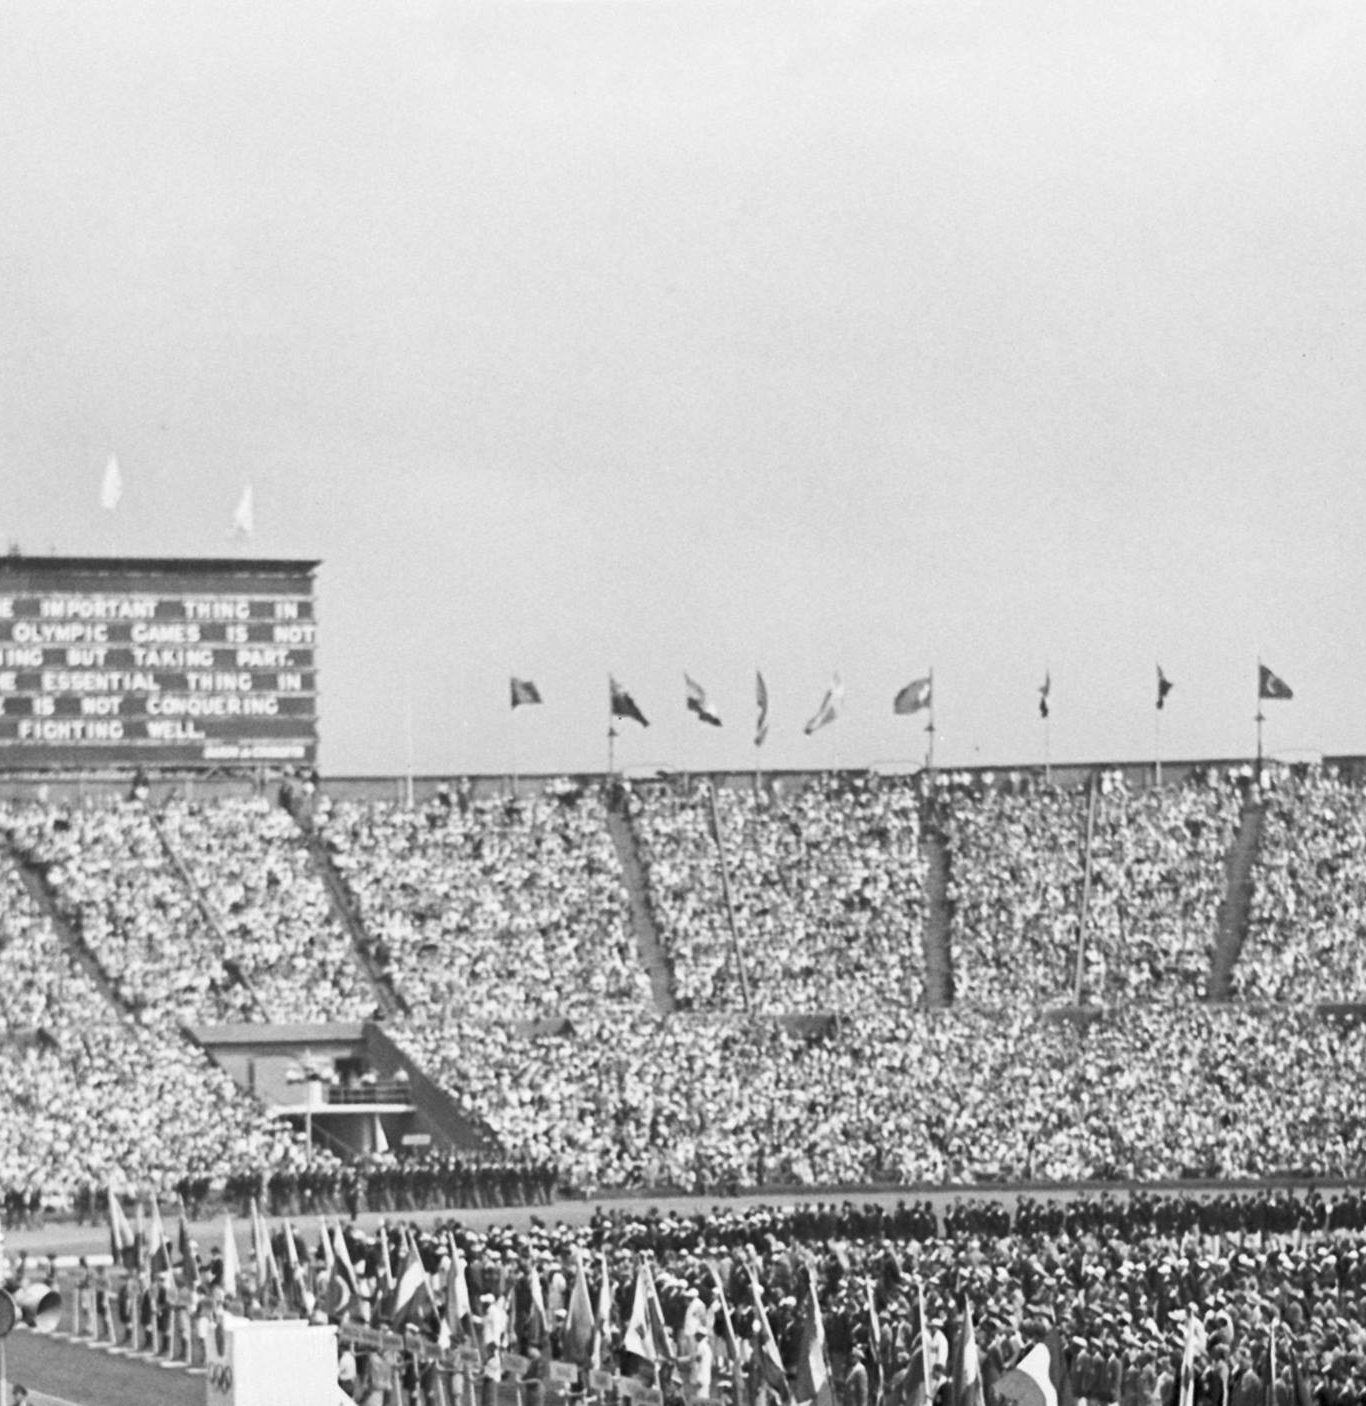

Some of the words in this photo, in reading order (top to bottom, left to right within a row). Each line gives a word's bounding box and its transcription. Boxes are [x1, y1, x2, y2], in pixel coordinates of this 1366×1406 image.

[40, 600, 157, 618] IMPORTANT
[183, 600, 250, 618] THING
[274, 600, 298, 618] IN
[12, 624, 108, 643] OLYMPIC
[131, 624, 200, 643] GAMES
[226, 624, 248, 643] IS
[273, 624, 316, 643] NOT
[66, 649, 107, 667] BUT
[135, 649, 214, 667] TAKING
[237, 649, 294, 667] PART.
[42, 673, 161, 691] ESSENTIAL
[187, 673, 252, 691] THING
[278, 673, 302, 691] IN
[32, 697, 55, 716] IS
[81, 697, 123, 716] NOT
[146, 697, 279, 716] CONQUERING
[18, 721, 124, 740] FIGHTING
[146, 721, 206, 740] WELL.
